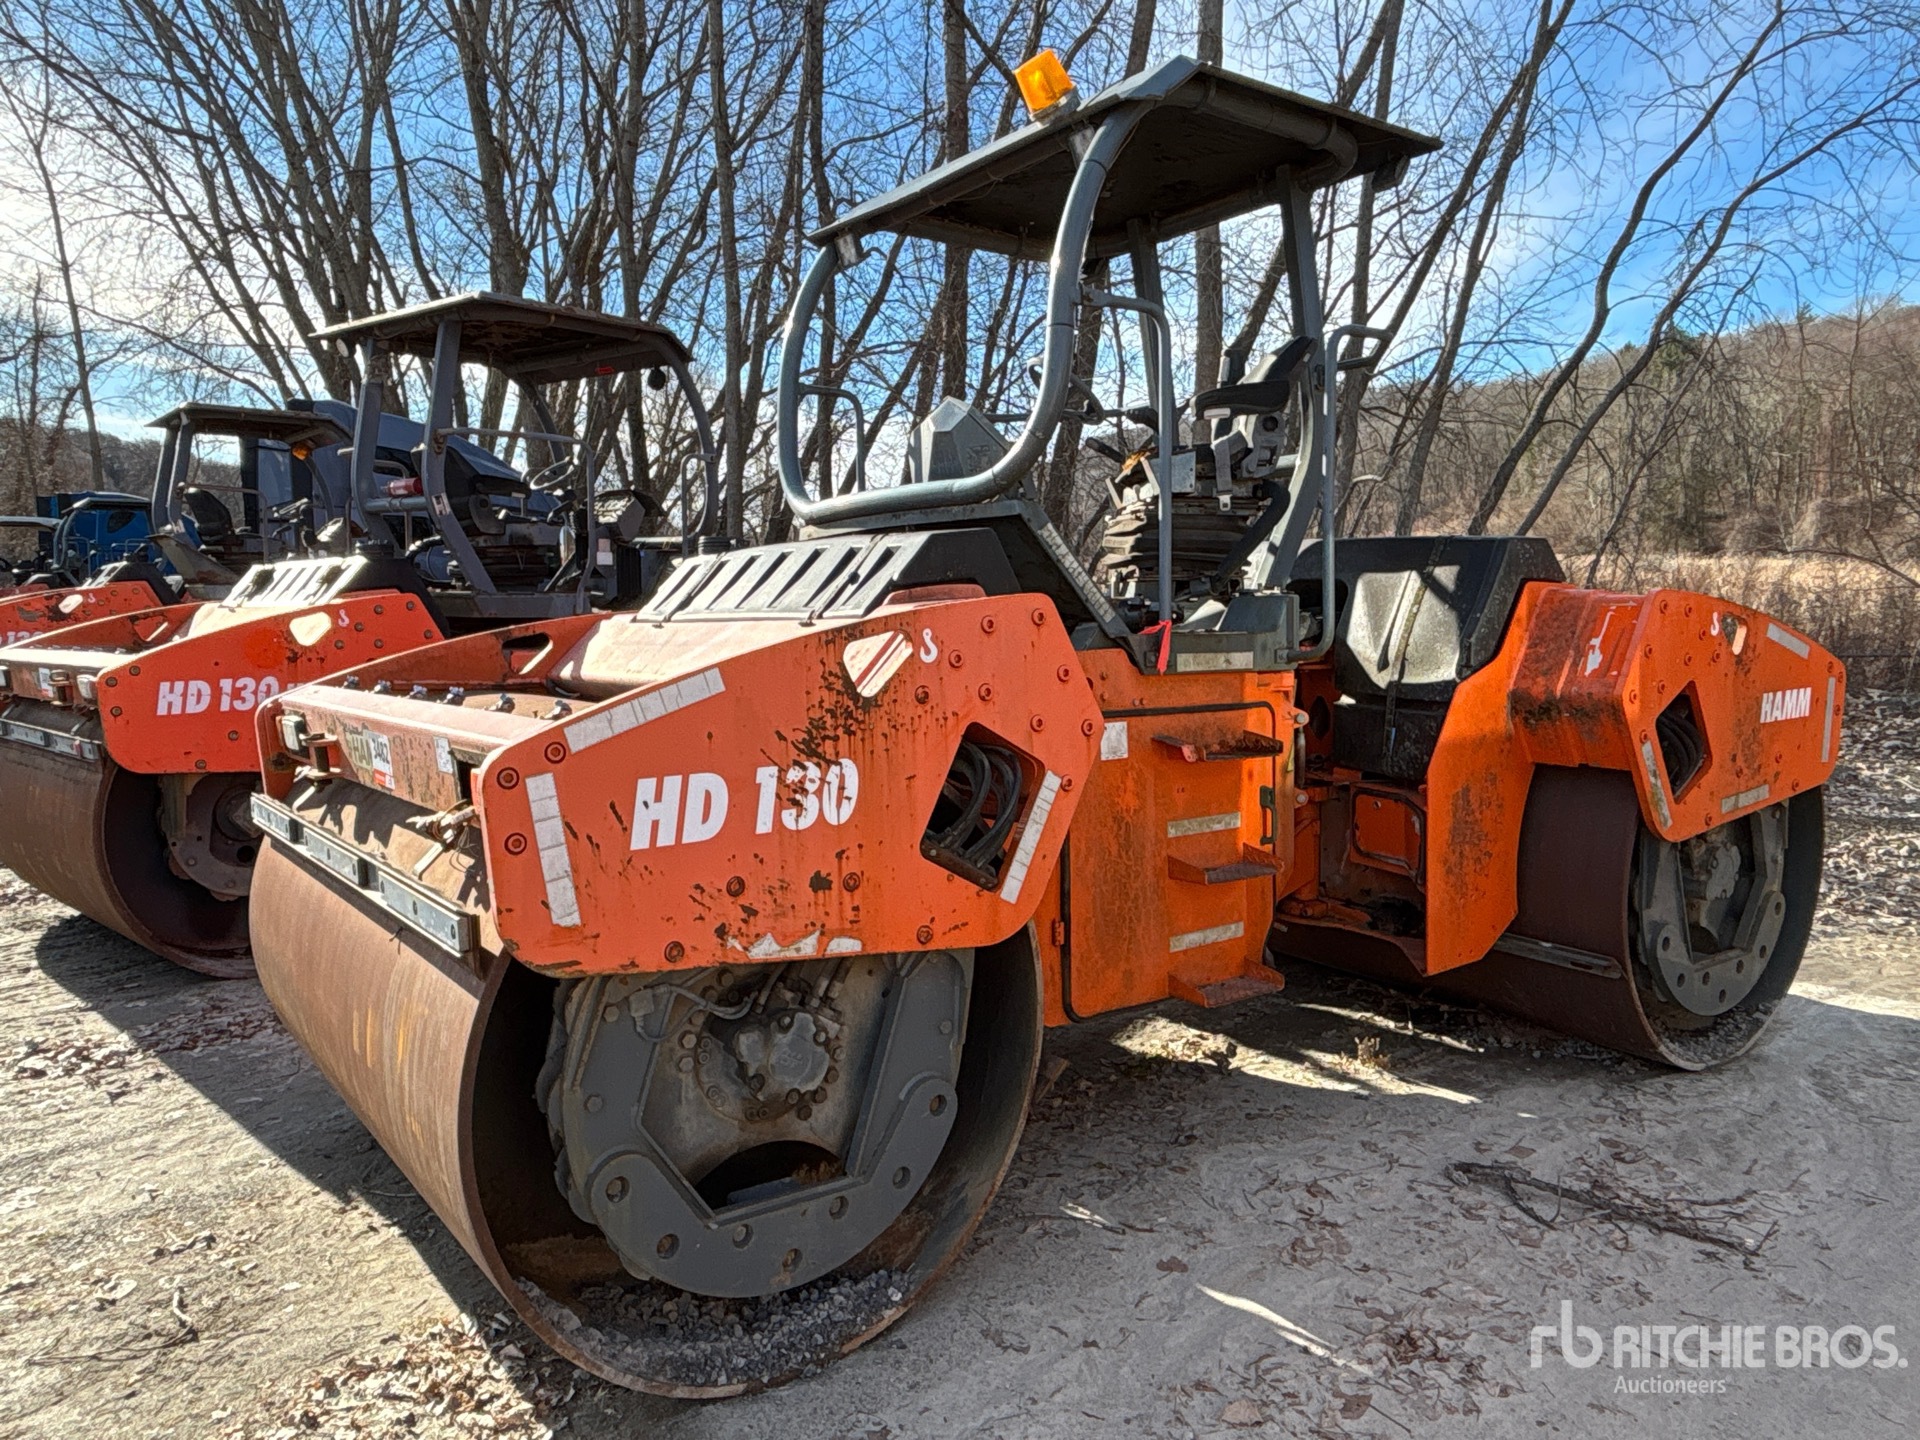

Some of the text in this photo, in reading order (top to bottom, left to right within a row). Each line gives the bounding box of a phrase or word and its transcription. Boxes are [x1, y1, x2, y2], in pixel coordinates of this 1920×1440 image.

[156, 675, 280, 716] HD 130
[1759, 687, 1812, 723] HAMM
[630, 758, 859, 850] HD 130
